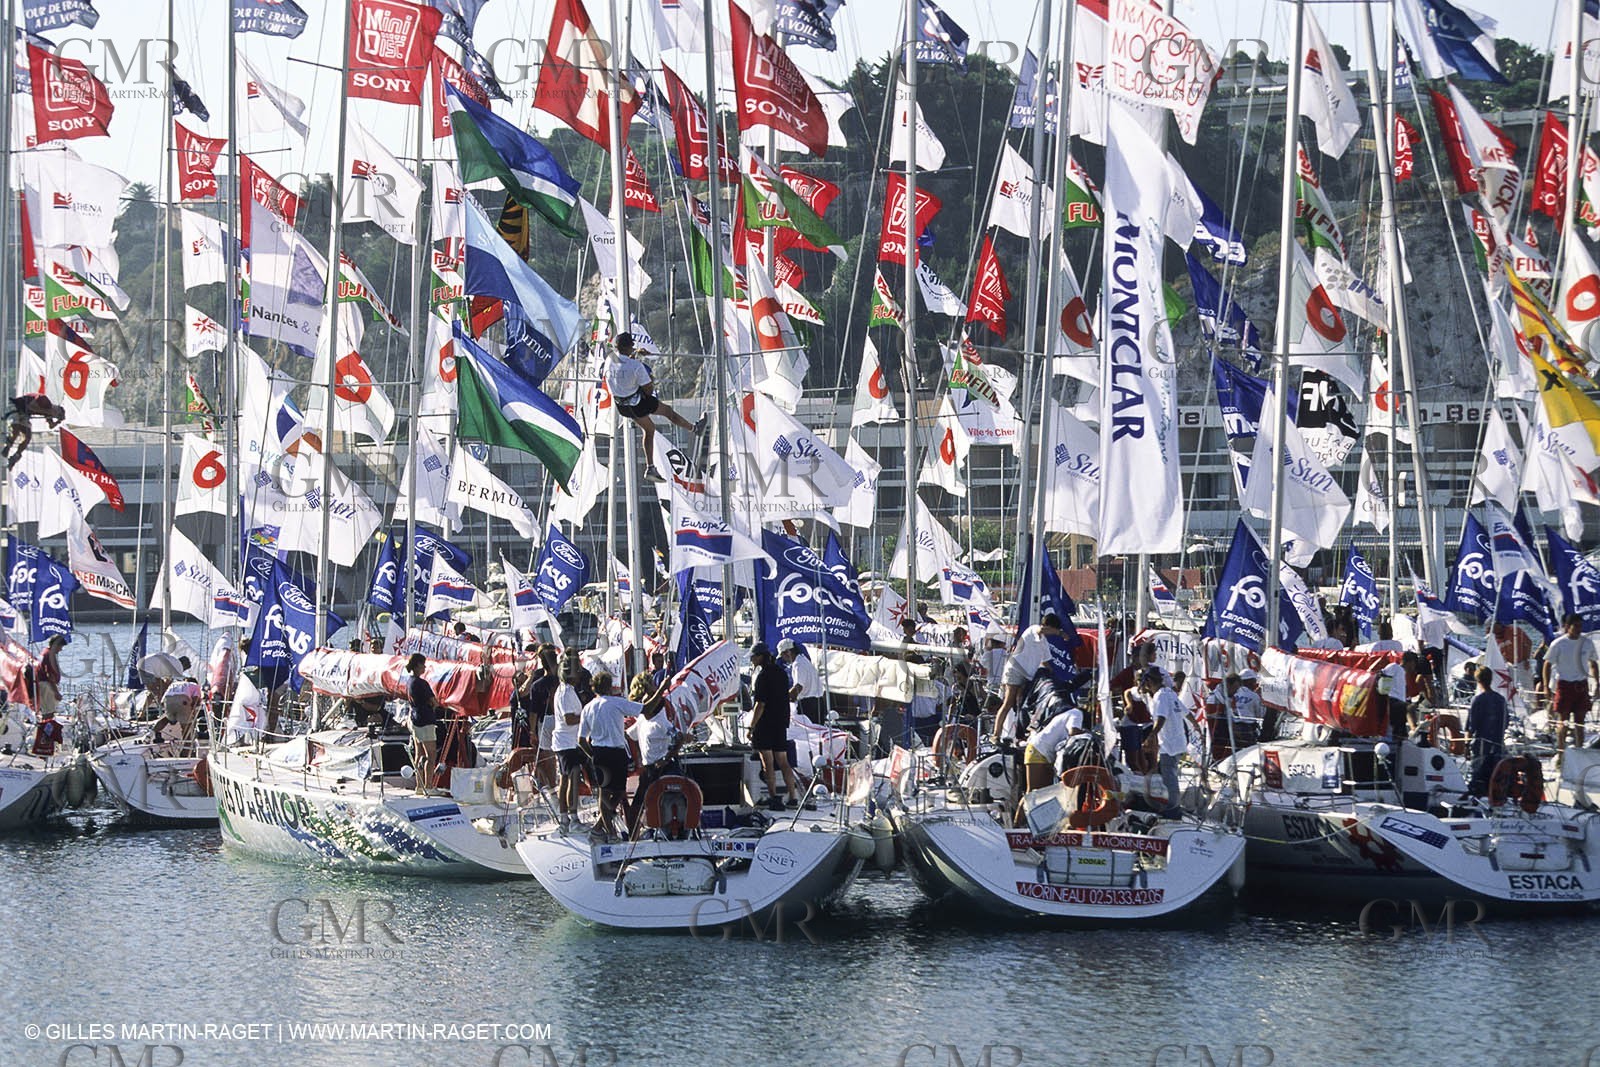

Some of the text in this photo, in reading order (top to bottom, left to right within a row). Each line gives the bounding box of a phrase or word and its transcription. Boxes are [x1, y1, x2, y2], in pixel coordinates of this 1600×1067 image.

[26, 8, 45, 20] OUR
[61, 1, 96, 14] FRANC
[234, 8, 252, 18] OUR
[365, 7, 413, 36] Mini
[787, 19, 819, 39] VOILE
[363, 29, 408, 60] Disc
[352, 72, 412, 93] SONY
[47, 116, 95, 132] SONY
[744, 98, 808, 132] SONY
[624, 187, 655, 204] ONY
[757, 201, 790, 221] FUJ
[1068, 202, 1101, 222] FU
[881, 241, 919, 256] SON
[53, 294, 113, 313] FUJIFIL
[251, 305, 299, 330] Nantes
[631, 333, 655, 346] TIM
[1177, 407, 1208, 425] tel
[80, 469, 98, 481] LLY
[193, 450, 227, 488] 6
[1292, 456, 1333, 493] Sun
[555, 542, 579, 564] Ford
[10, 560, 37, 592] foc
[1457, 552, 1497, 589] foc
[775, 573, 854, 617] focus
[776, 614, 856, 630] Lancement Officiel
[781, 626, 792, 638] 1er
[829, 627, 850, 638] 1998
[1157, 638, 1208, 660] ATHENA
[1287, 763, 1316, 777] ESTACA
[1099, 835, 1162, 852] MORINEAU
[548, 860, 587, 876] ONET
[757, 852, 799, 868] ONET
[1077, 857, 1107, 866] ZODIAC
[1508, 874, 1584, 890] ESTACA
[1019, 883, 1086, 903] MORINEAU
[1509, 891, 1528, 900] Port
